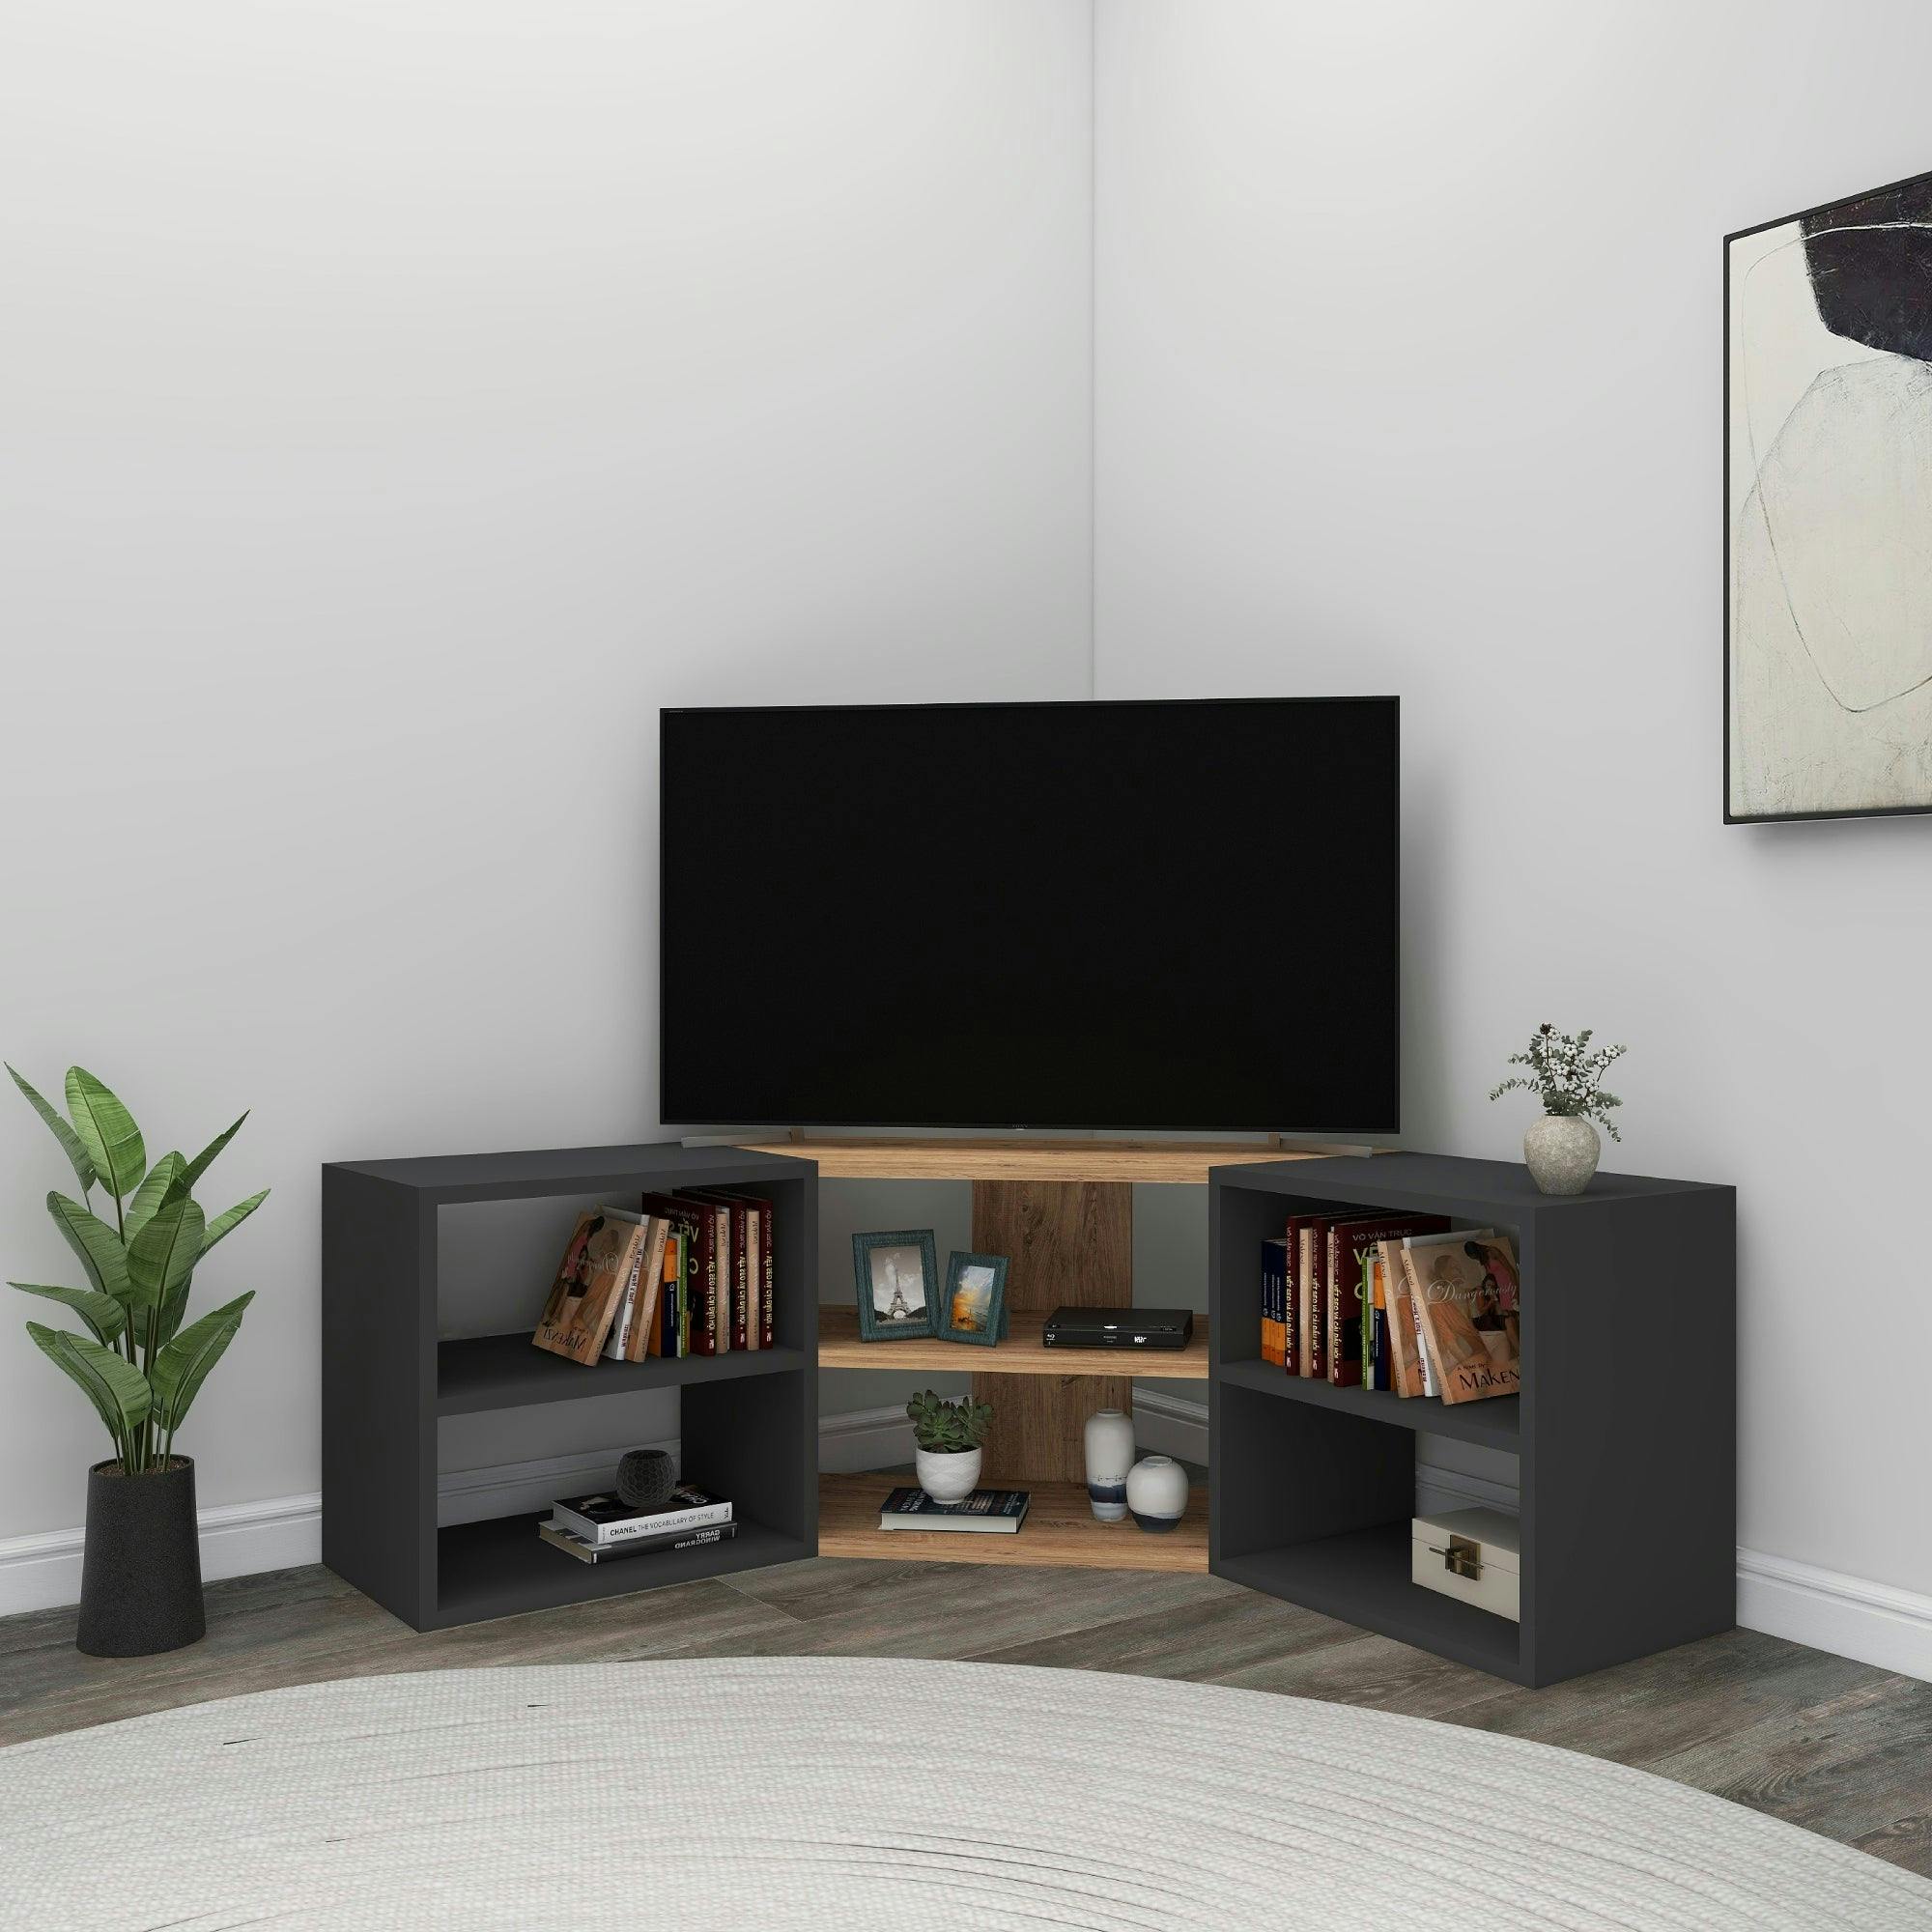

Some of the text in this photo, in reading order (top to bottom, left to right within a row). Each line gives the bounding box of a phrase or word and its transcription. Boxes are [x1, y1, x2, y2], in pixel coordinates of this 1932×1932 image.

[610, 1526, 637, 1536] CHANEL
[638, 1523, 649, 1532] THE
[649, 1517, 688, 1530] VOCABULARY
[697, 1512, 715, 1521] STYLE
